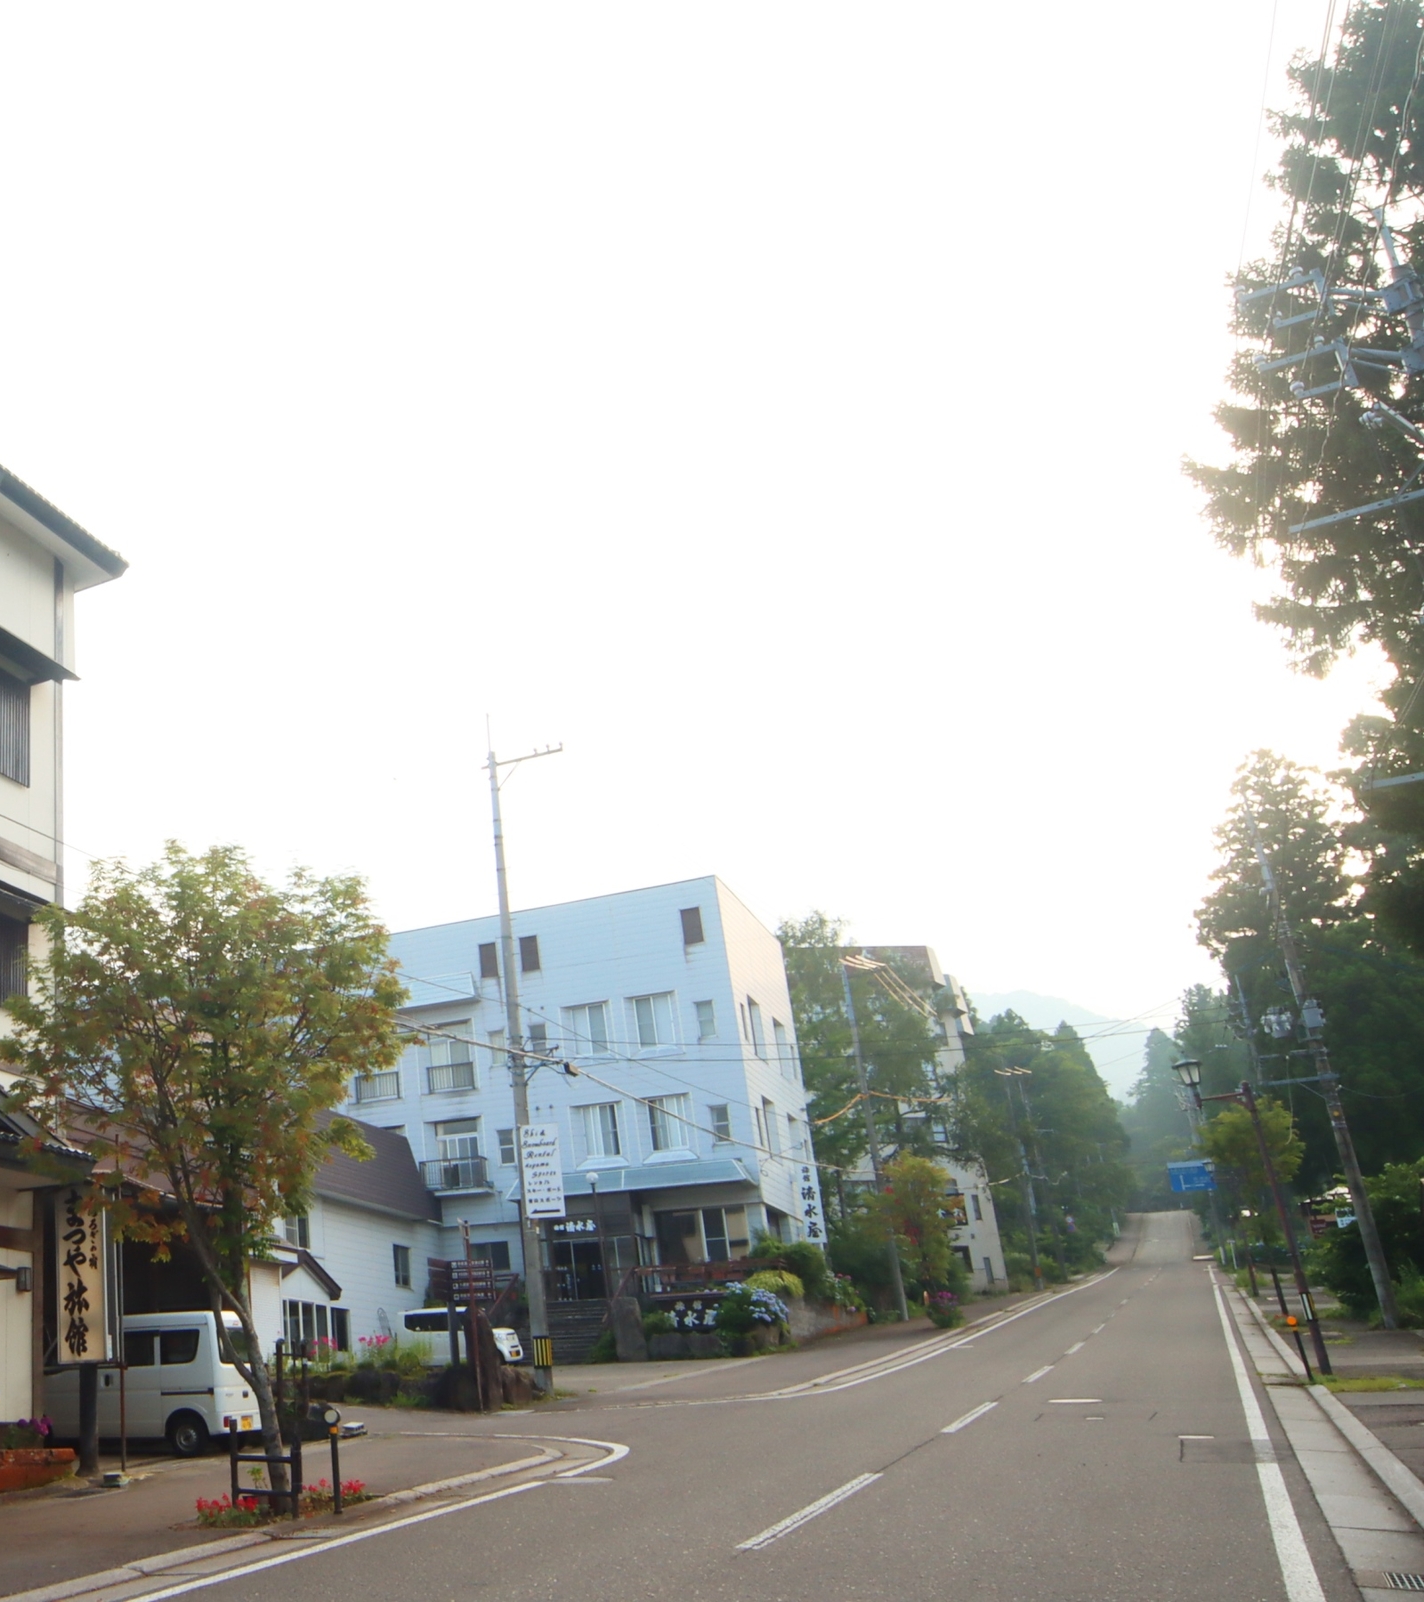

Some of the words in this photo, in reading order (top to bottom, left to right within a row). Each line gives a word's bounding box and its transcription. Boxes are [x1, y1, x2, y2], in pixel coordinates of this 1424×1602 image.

[524, 1148, 556, 1160] Rental
[801, 1185, 822, 1238] 清水屋
[62, 1190, 90, 1357] まつや旅館
